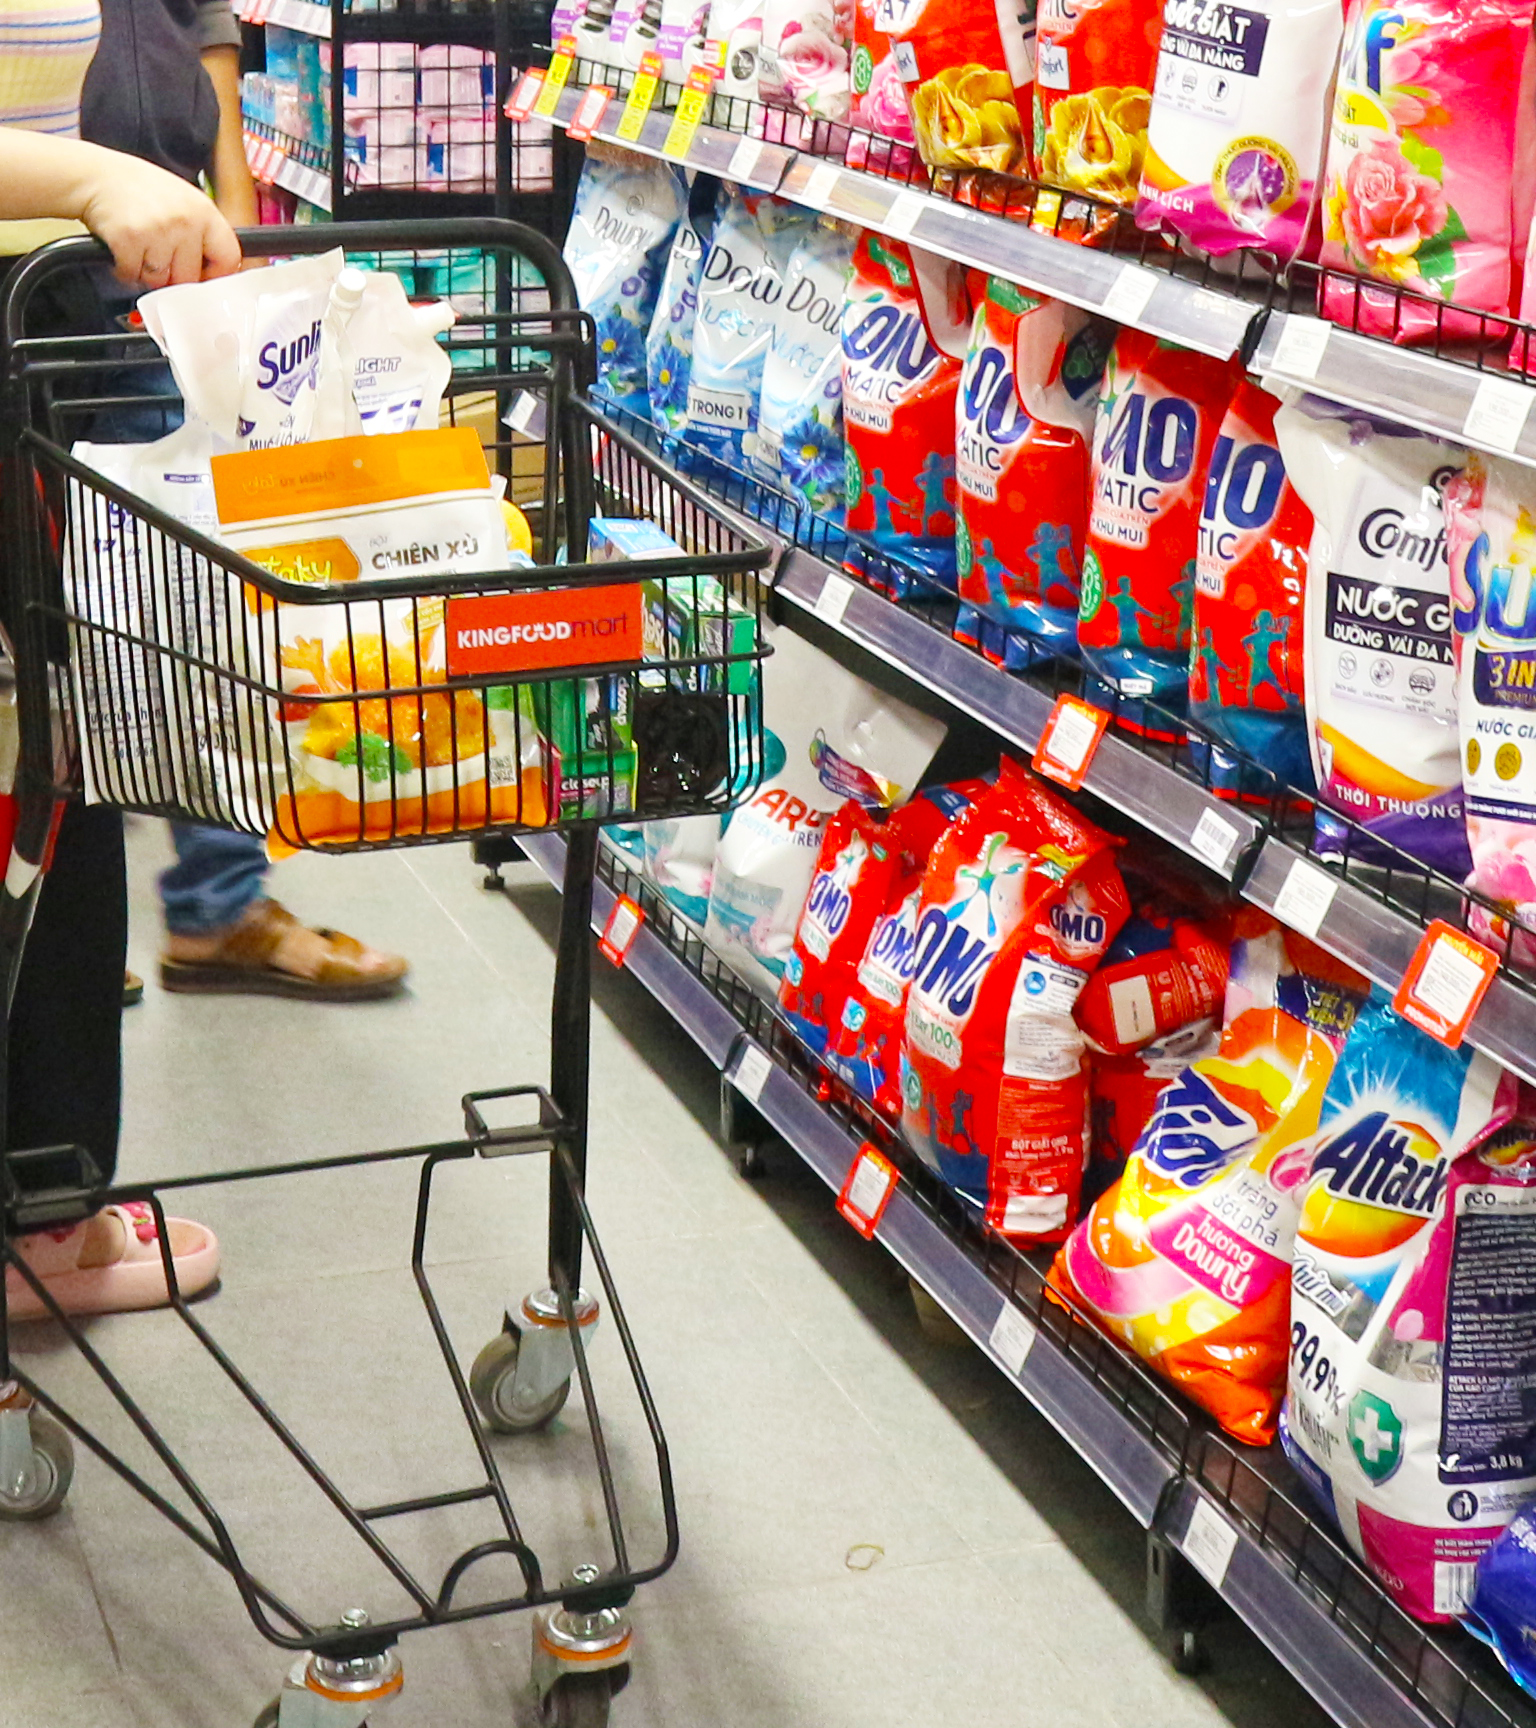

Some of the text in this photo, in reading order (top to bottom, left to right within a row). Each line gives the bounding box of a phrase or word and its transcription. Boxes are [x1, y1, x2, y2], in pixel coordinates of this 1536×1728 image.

[1203, 46, 1245, 71] NĂNG
[1161, 193, 1195, 215] LỊCH
[705, 245, 784, 305] Dow
[257, 319, 323, 390] Sunli
[691, 397, 735, 419] TRONG
[371, 540, 439, 570] CHIÊN
[1336, 583, 1419, 627] NƯỚC
[1333, 623, 1439, 660] DƯỠNG VẢI ĐA
[1476, 717, 1513, 738] NƯỚC
[1335, 783, 1462, 823] THỜI THƯỢNG
[807, 873, 851, 935] OMO
[1051, 902, 1105, 944] OMO
[1312, 1110, 1449, 1219] Attack
[1197, 1212, 1255, 1273] hương
[1240, 1210, 1279, 1247] phá
[1173, 1221, 1251, 1302] Downy
